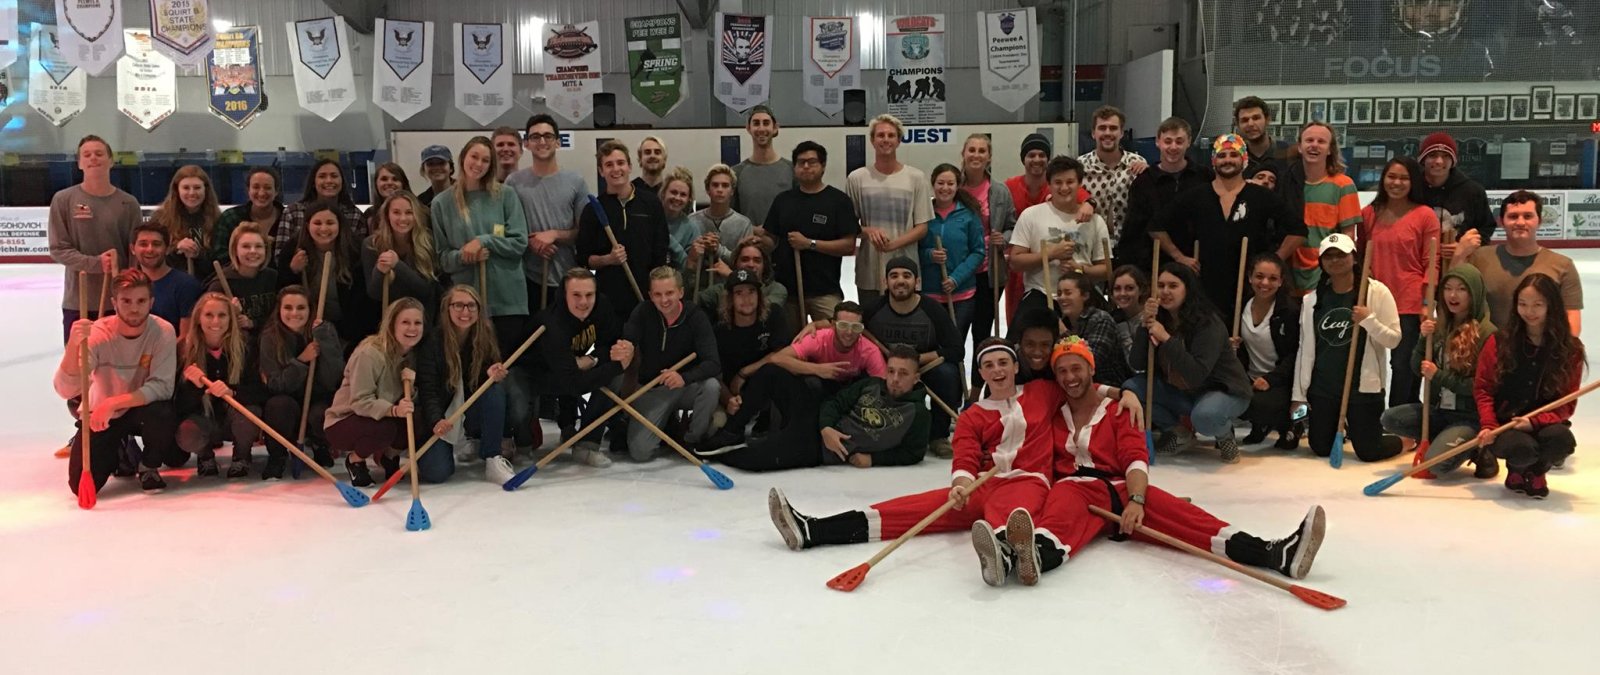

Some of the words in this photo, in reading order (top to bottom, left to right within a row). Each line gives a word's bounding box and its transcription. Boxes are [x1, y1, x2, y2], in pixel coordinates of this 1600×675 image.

[164, 8, 190, 16] SQUIRT
[169, 16, 194, 24] STATE
[630, 18, 676, 28] CHAMPIONS
[161, 24, 207, 32] CHAMPIONS
[650, 27, 667, 35] WEE
[990, 44, 1026, 53] Champions
[643, 58, 678, 68] SPRING
[1324, 55, 1440, 78] FOCUS
[889, 67, 943, 76] CHAMPIONS
[225, 101, 248, 111] 2016
[900, 128, 952, 144] UEST
